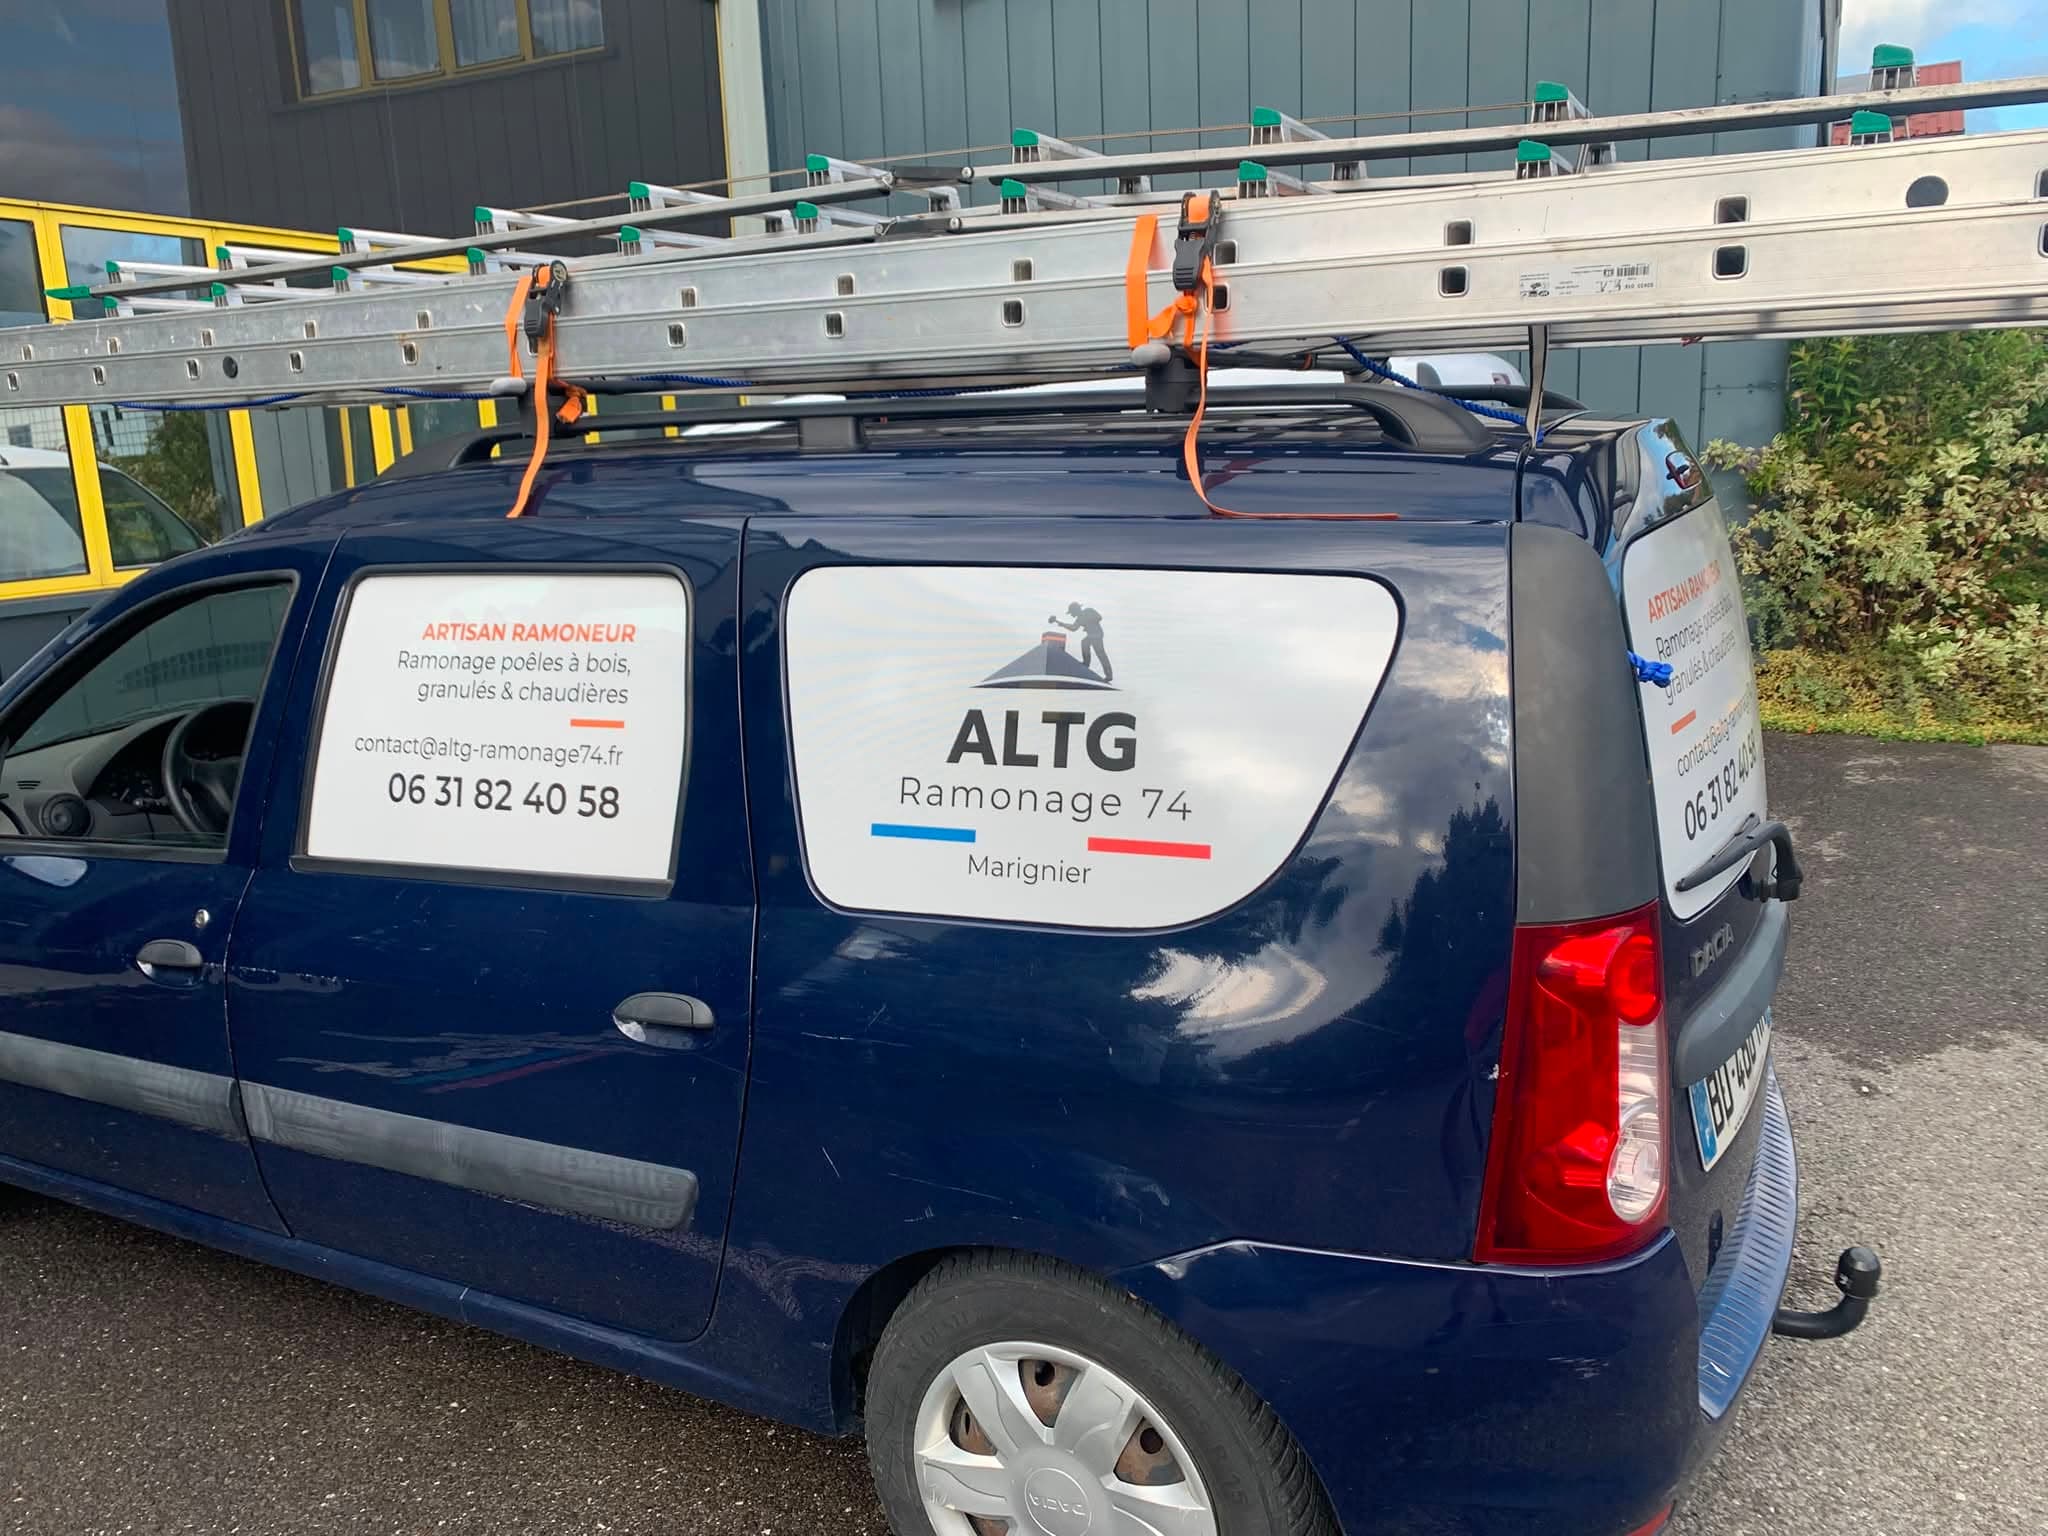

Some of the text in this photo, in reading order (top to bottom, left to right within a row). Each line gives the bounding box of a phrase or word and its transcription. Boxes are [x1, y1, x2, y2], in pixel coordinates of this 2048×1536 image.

[1647, 581, 1689, 624] ARTISAN
[422, 622, 637, 643] ARTISAN RAMONEUR
[1655, 617, 1704, 662] Ramonage
[398, 650, 632, 677] Ramonage poêles à bois,
[1664, 656, 1703, 706] granulés
[417, 679, 629, 704] granulés & chaudières
[354, 735, 623, 767] contact@altg-ramonage74.fr
[946, 708, 1137, 772] ALTG
[388, 772, 620, 819] 06 31 82 40 58
[900, 776, 1192, 823] Ramonage 74
[1684, 789, 1707, 841] 06
[1707, 774, 1723, 820] 31
[1723, 758, 1738, 803] 82
[1738, 741, 1749, 783] 40
[967, 853, 1092, 885] Marignier
[1690, 922, 1735, 977] DACIA
